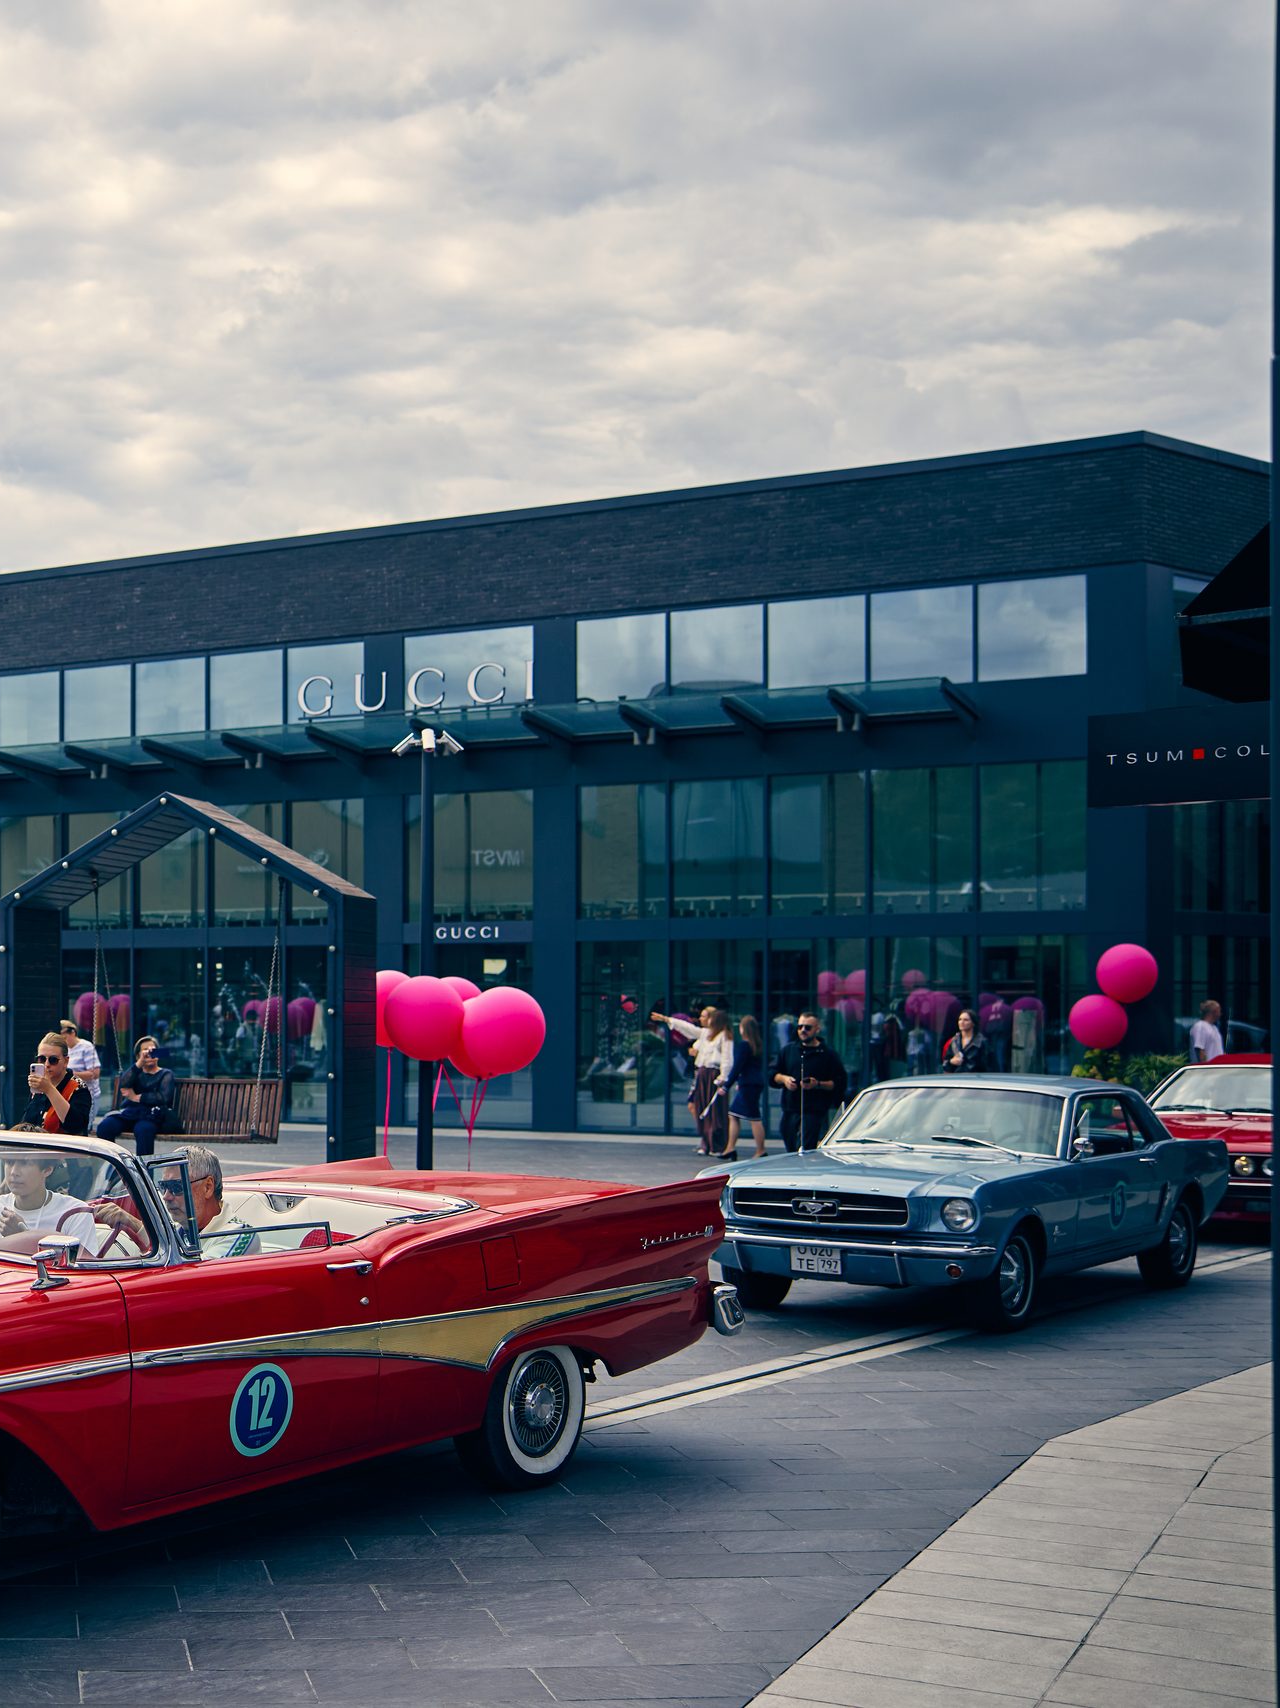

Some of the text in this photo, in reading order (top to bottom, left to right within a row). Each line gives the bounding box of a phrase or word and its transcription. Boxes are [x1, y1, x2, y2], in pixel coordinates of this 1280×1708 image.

[298, 661, 534, 715] GUCCI
[1106, 744, 1270, 766] TSUM COL
[435, 926, 499, 940] GUCCI
[820, 1259, 838, 1270] 797
[248, 1375, 276, 1431] 12
